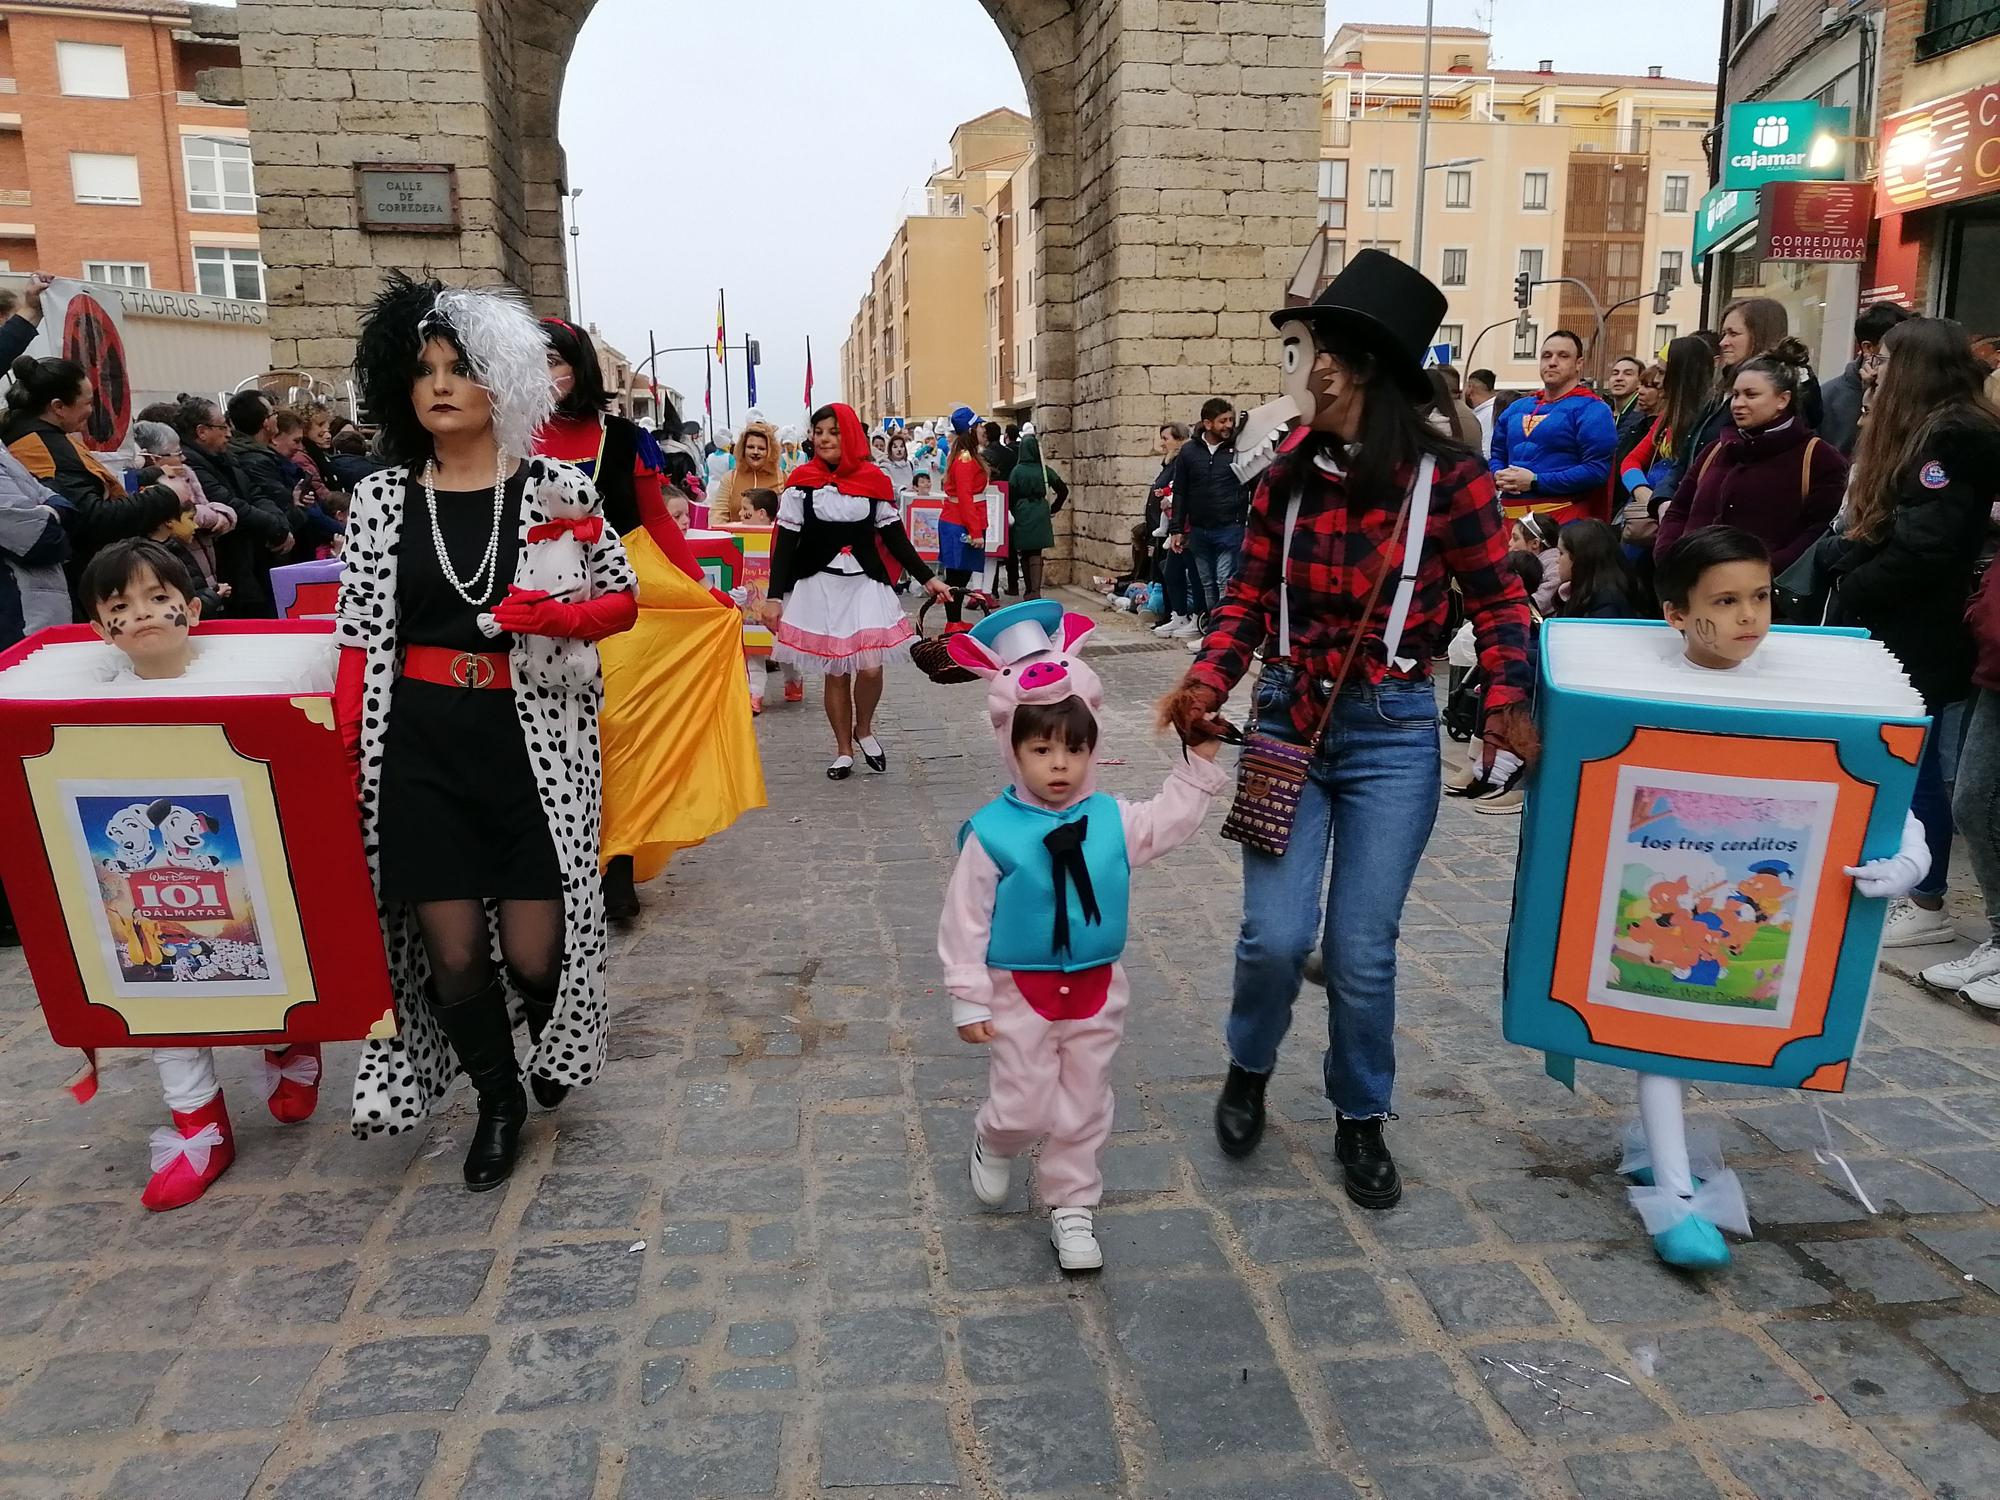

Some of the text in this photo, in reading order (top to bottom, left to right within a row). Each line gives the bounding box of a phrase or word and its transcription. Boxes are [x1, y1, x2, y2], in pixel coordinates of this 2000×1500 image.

[1731, 150, 1808, 171] cajamar
[386, 181, 423, 191] CALLE
[399, 193, 414, 202] DE
[378, 203, 443, 213] CORREDERA
[1771, 235, 1865, 248] CORREDURIA
[1773, 248, 1861, 260] DE SEGUROS
[129, 291, 200, 319] TAURUS
[211, 301, 262, 325] TAPAS
[1679, 837, 1715, 853] tres
[1720, 836, 1799, 853] cerditos
[166, 871, 201, 884] Disney
[138, 884, 222, 908] 101
[142, 907, 227, 918] DÁLMATAS
